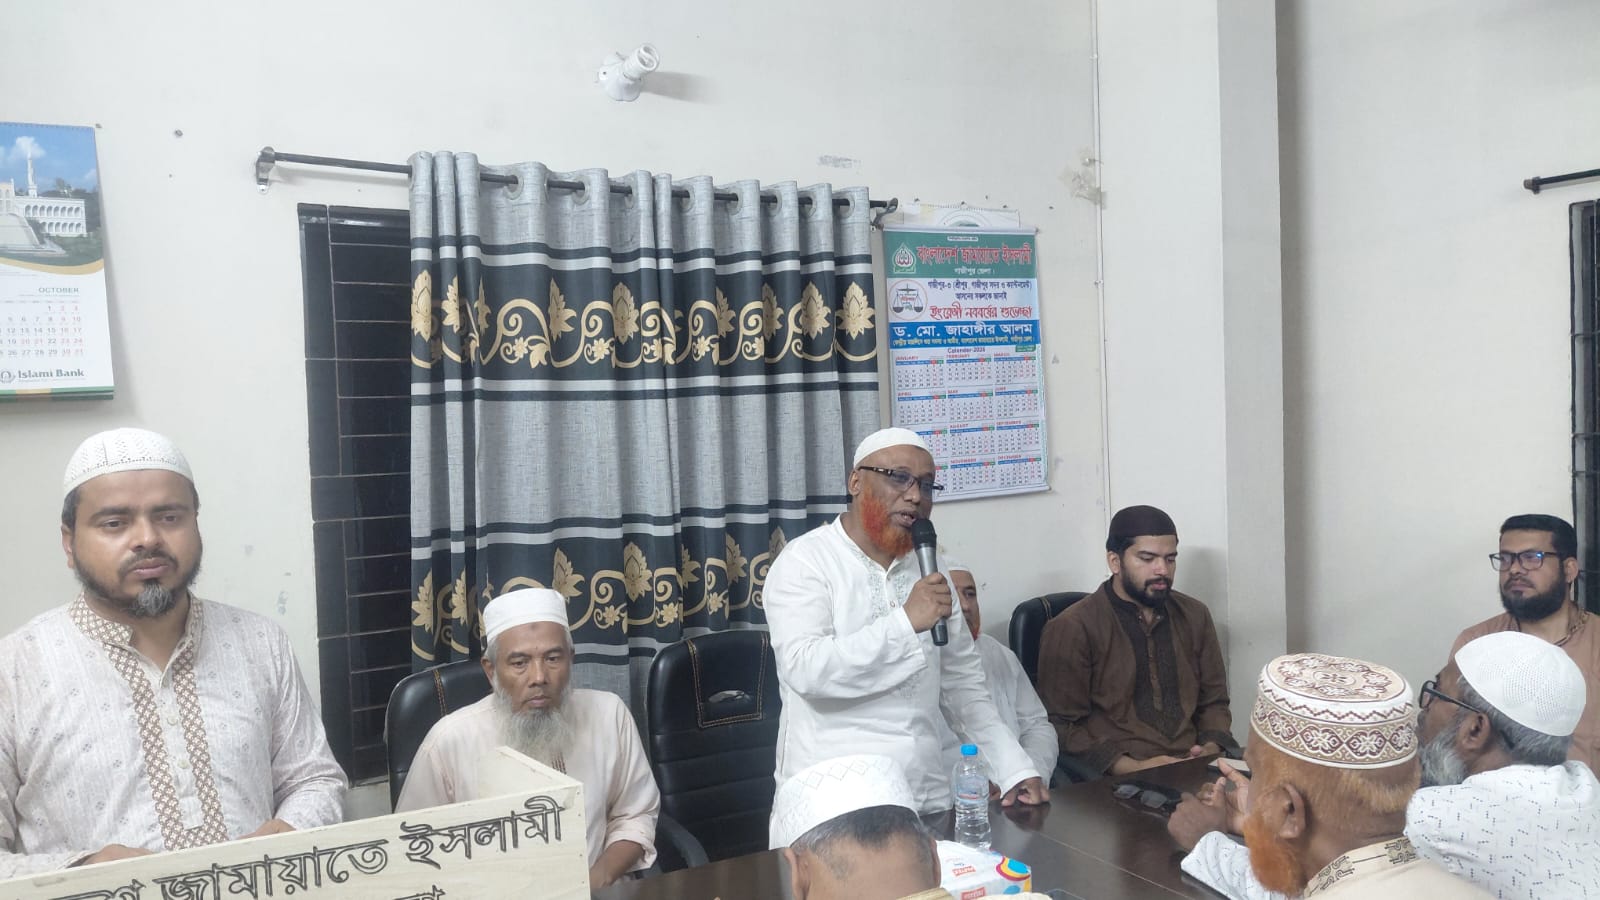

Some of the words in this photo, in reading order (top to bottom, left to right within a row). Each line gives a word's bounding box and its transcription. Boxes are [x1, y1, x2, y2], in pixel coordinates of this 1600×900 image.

[916, 245, 959, 265] বাংলাদেশ
[961, 245, 1001, 265] জামায়াতে
[1001, 242, 1032, 265] ইসলামী
[892, 326, 911, 338] ড.
[916, 326, 940, 337] মো.
[944, 320, 996, 336] জাহাঙ্গীর
[998, 324, 1033, 335] আলম
[18, 370, 54, 378] Islami
[56, 368, 84, 377] Bank
[152, 839, 389, 900] জামায়াতে
[399, 795, 566, 870] ইসলামী
